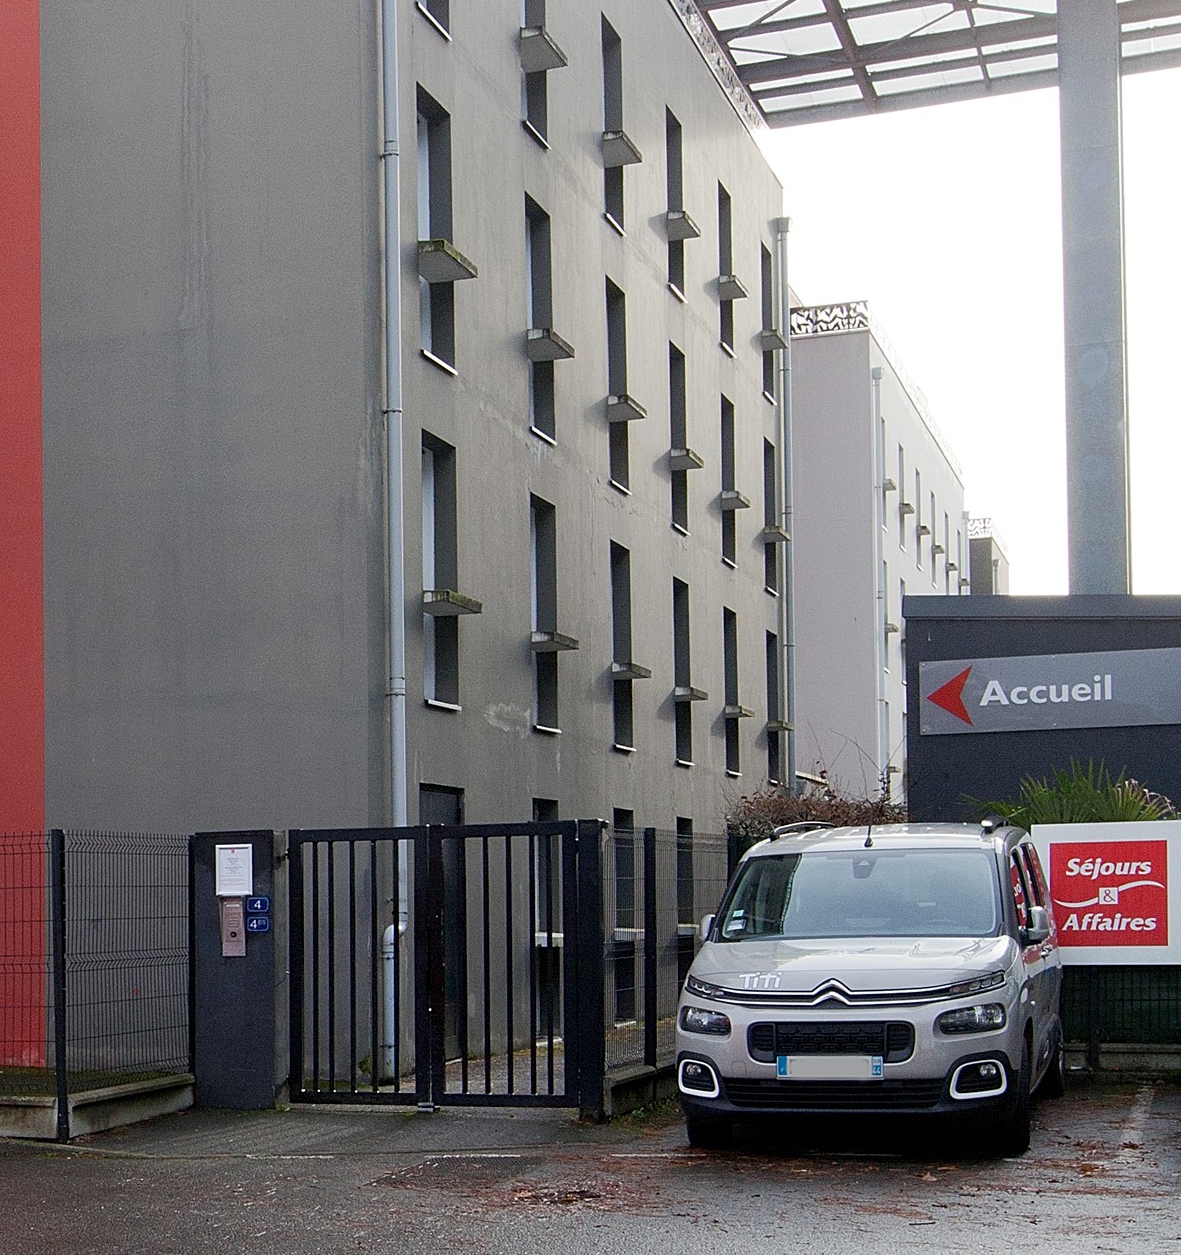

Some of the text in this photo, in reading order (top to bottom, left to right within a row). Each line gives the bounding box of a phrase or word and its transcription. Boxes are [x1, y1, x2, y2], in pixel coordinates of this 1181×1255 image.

[979, 674, 1112, 707] Accueil
[1065, 857, 1152, 881] Séjours
[254, 900, 261, 909] 4
[1103, 889, 1116, 903] &
[1061, 912, 1157, 931] Affaires
